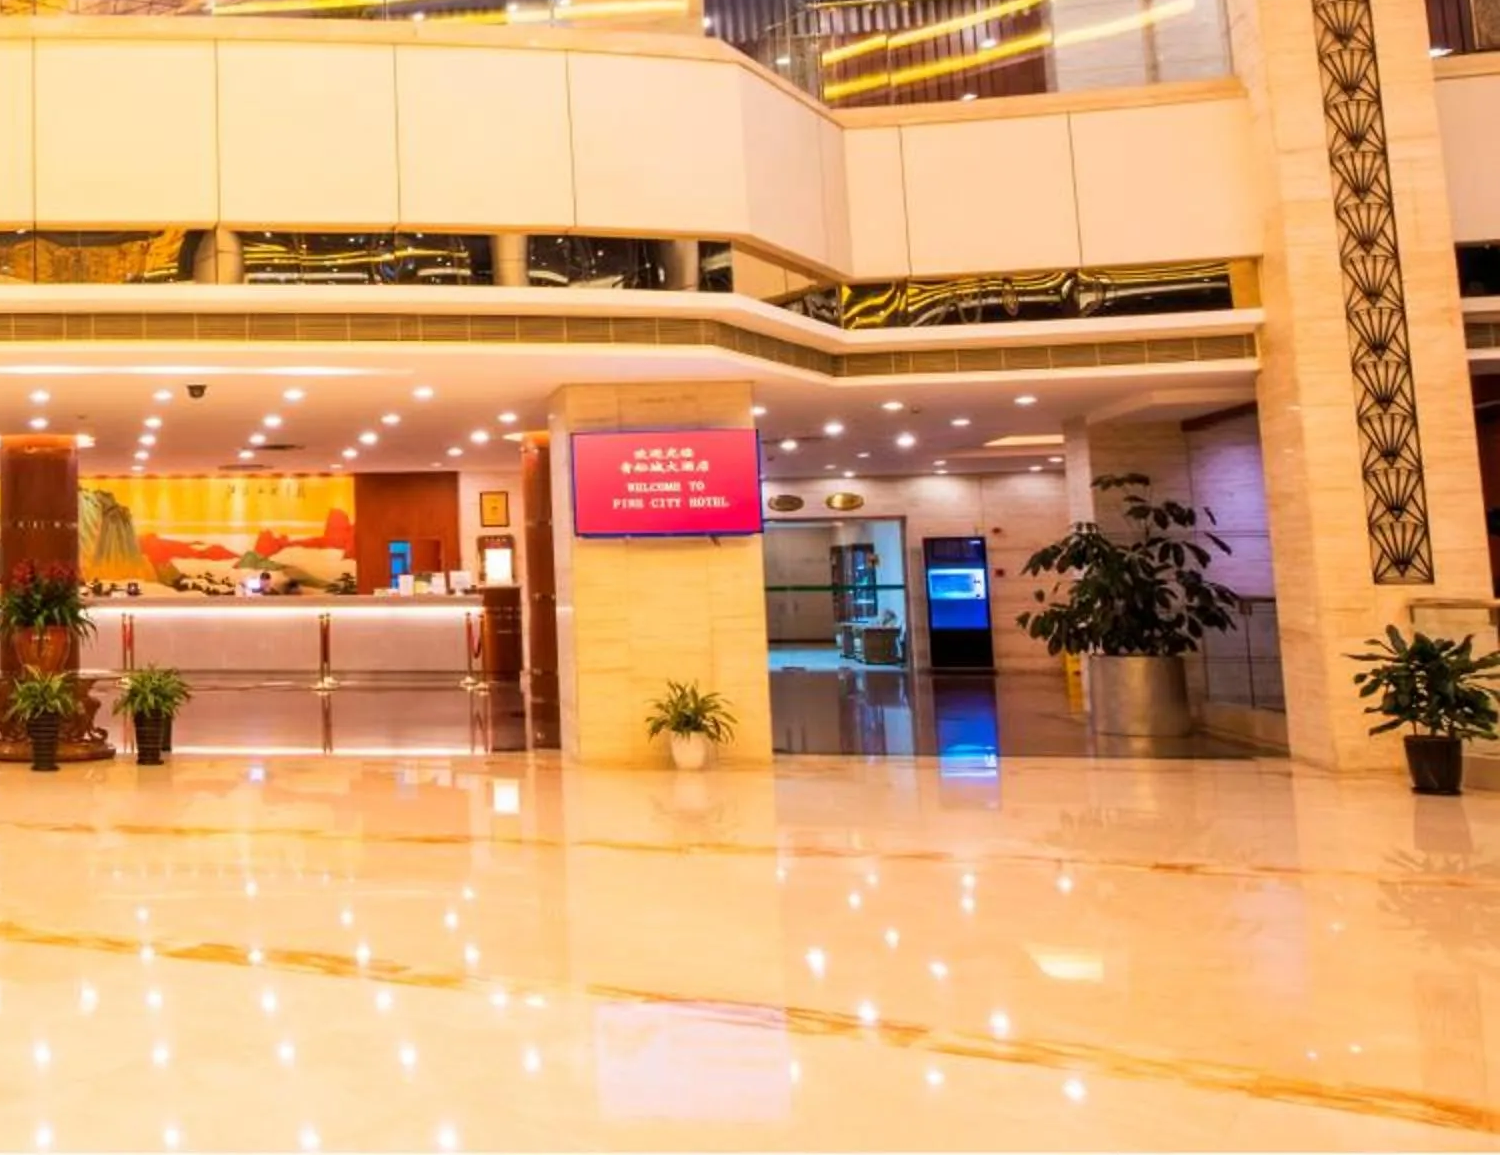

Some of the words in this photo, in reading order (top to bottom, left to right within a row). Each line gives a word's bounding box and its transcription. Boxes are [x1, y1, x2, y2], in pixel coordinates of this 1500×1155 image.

[627, 481, 681, 492] WELCOME
[688, 480, 705, 491] TO
[613, 498, 644, 509] PINE
[650, 497, 681, 508] CITY
[689, 496, 729, 507] HOTEL
